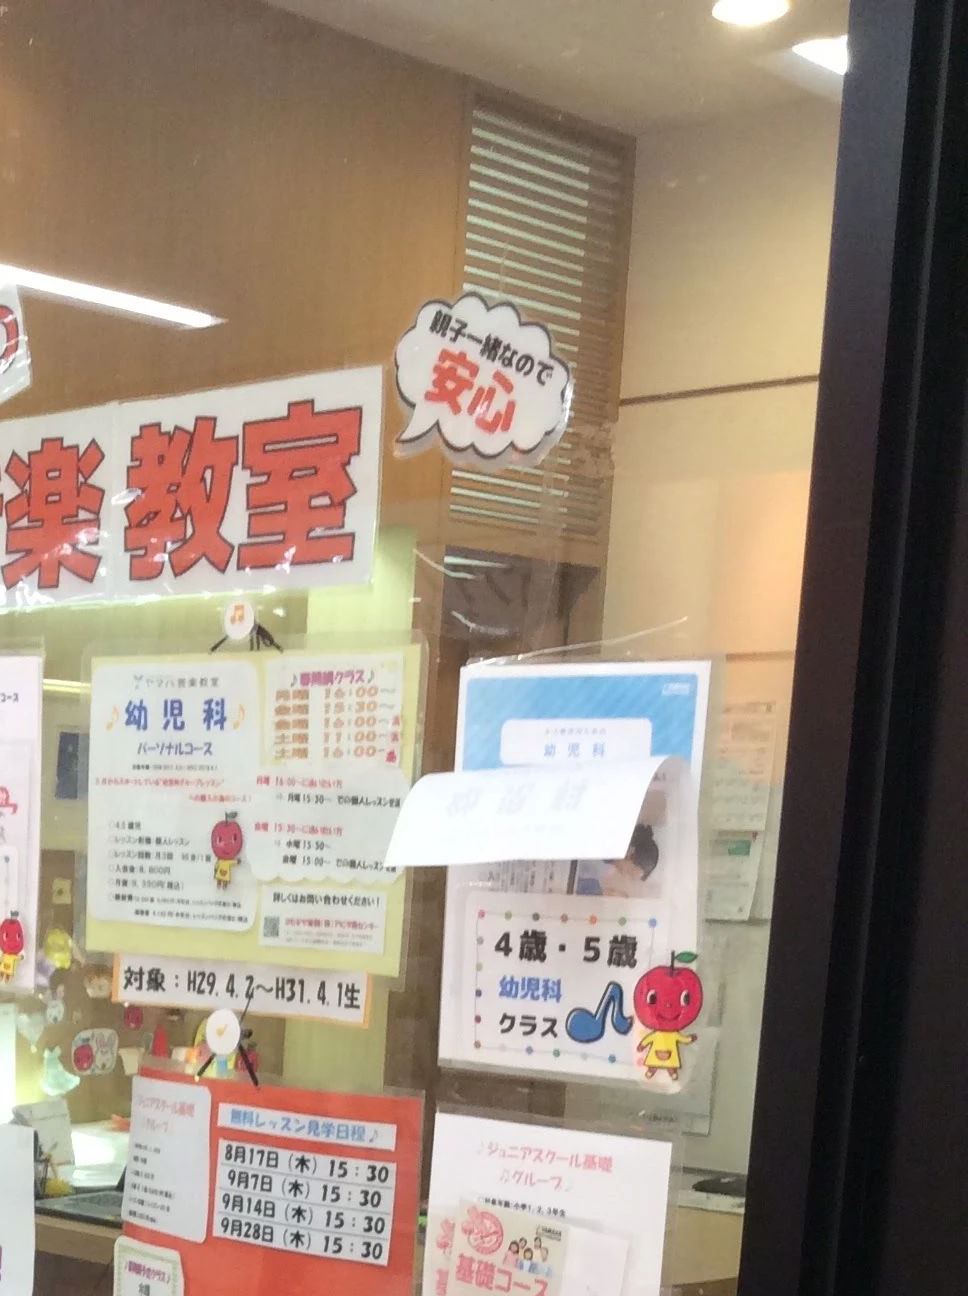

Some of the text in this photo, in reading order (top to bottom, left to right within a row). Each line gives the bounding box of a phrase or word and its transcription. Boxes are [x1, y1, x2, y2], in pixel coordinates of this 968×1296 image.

[429, 309, 555, 386] 親子一緒なので
[423, 349, 517, 434] 安心
[125, 698, 227, 731] 幼児科
[137, 742, 213, 756] パーソナルコース
[494, 929, 638, 968] 4歳・5歳
[498, 974, 563, 1003] 幼児科
[498, 1012, 559, 1039] クラス
[230, 1108, 366, 1142] 無料レッスン見学日程
[488, 1141, 614, 1173] ジュニアスクール基礎
[511, 1169, 564, 1191] グループ
